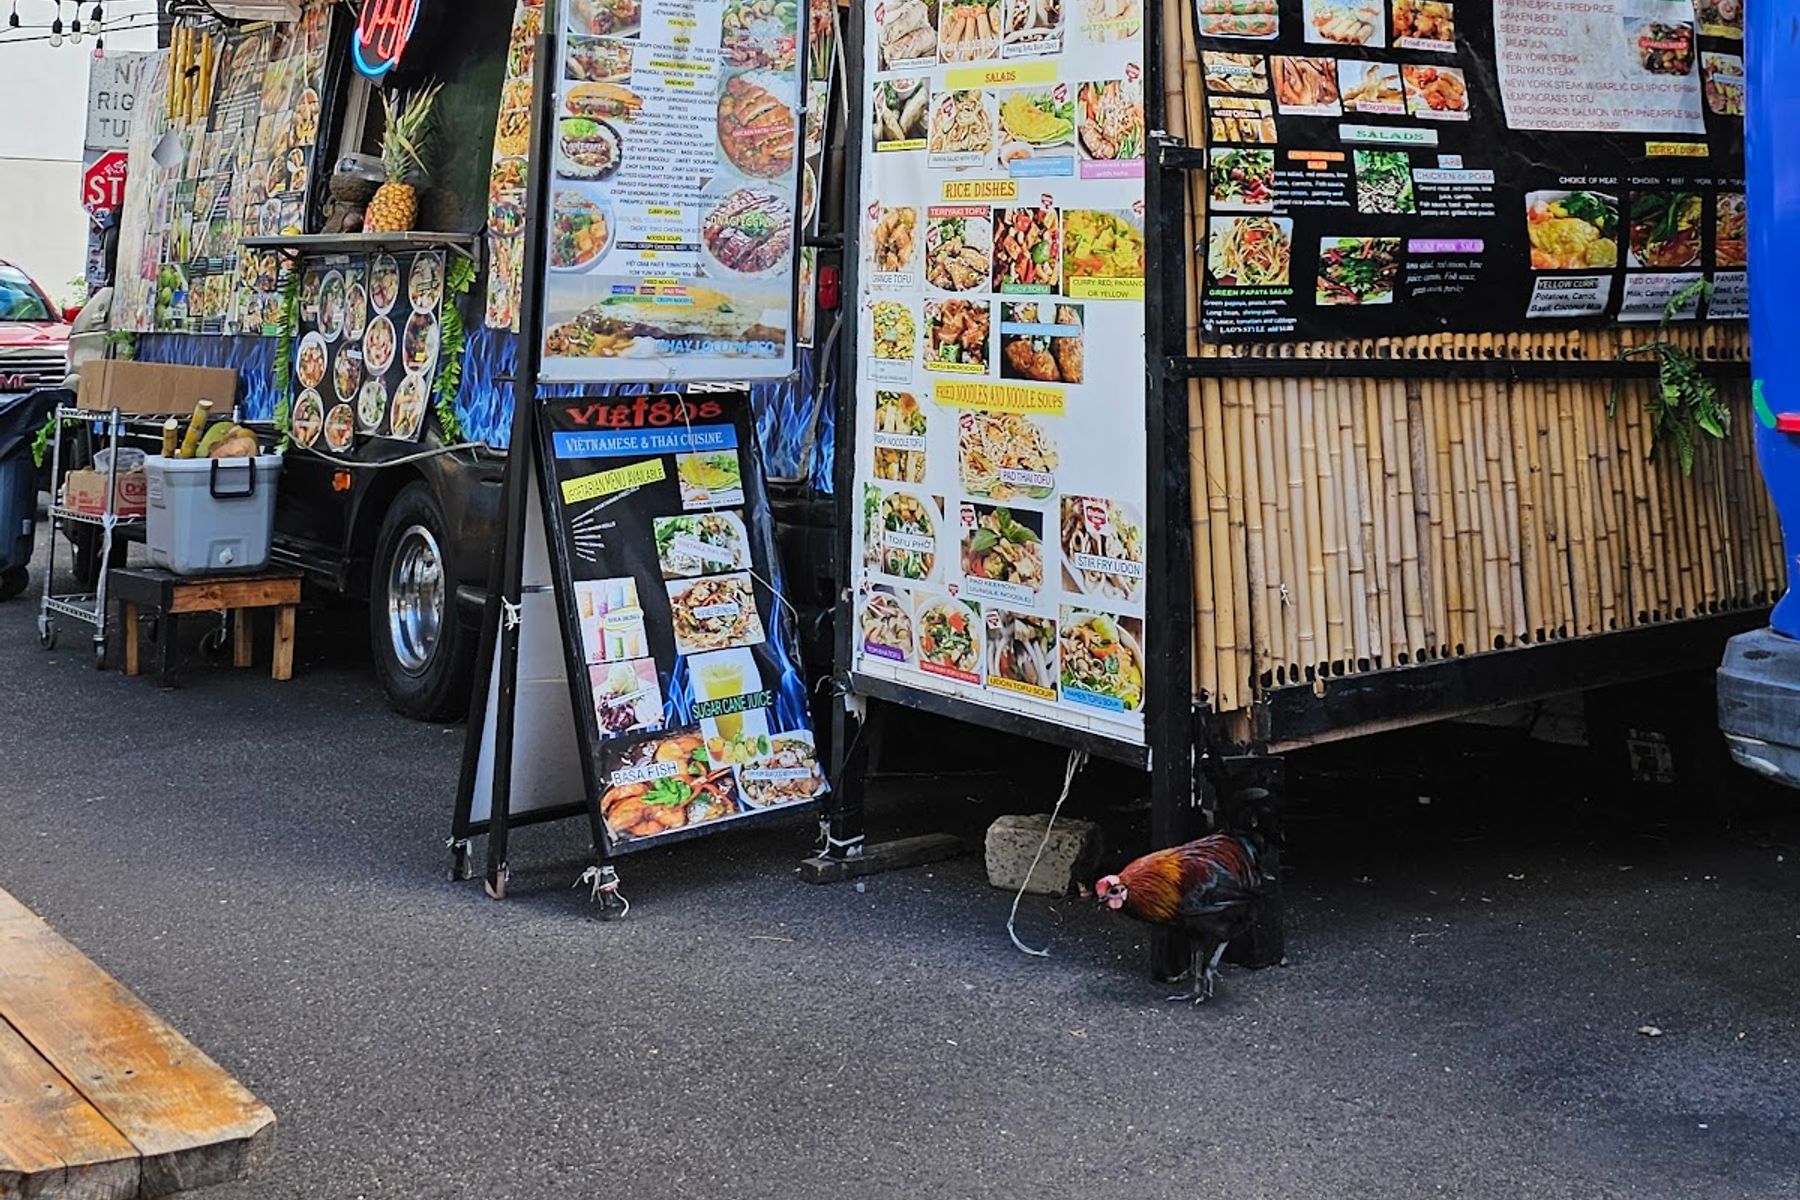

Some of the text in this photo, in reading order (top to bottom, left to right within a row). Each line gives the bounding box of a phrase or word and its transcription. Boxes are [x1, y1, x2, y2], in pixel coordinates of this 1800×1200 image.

[1516, 0, 1563, 11] PINEAPPLE
[1564, 1, 1593, 12] FRIED
[1593, 4, 1615, 13] RICE
[1500, 24, 1523, 34] BEEF
[1505, 38, 1528, 49] MEAT
[1502, 52, 1580, 64] NEW YORK STEAK
[114, 63, 131, 85] N
[1505, 64, 1576, 76] TERIYAKI STEAK
[984, 71, 1017, 85] SALADS
[1504, 78, 1527, 89] NEW
[1527, 79, 1553, 89] YORK
[1555, 80, 1584, 90] STEAK
[1645, 83, 1673, 93] SPICY
[97, 91, 135, 111] RIG
[1506, 92, 1594, 104] LEMONGRASS TOFU
[1509, 105, 1684, 119] LEMONGRASS SALMON WITH PINEAPPLE
[1535, 119, 1551, 128] OR
[1551, 119, 1586, 129] GARLIC
[1356, 129, 1425, 141] SALADS
[1648, 144, 1678, 154] CURRY
[1415, 171, 1494, 182] CHICKEN PORK
[1558, 176, 1587, 185] CHOICE
[1588, 177, 1599, 185] OF
[88, 175, 124, 206] ST
[944, 180, 1016, 199] RICE DISHES
[930, 206, 987, 218] TERIYAKI TOFU
[893, 272, 913, 286] TOFU
[1072, 279, 1097, 289] CURRY
[1539, 280, 1572, 289] YELLOW
[1087, 290, 1129, 299] OR YELLOW
[1208, 288, 1239, 297] GREEN
[1269, 287, 1294, 296] SALAD
[0, 374, 41, 390] MC
[936, 384, 1063, 409] FRIED NOODLES AND NOODLE SOUPS
[640, 438, 649, 449] &
[680, 431, 725, 447] CUISINE
[567, 467, 665, 502] VEGETARIAN MENU AVAILABLE
[1002, 470, 1017, 482] PAD
[1033, 474, 1051, 486] TOFU
[887, 535, 909, 547] TOFU
[1077, 554, 1141, 576] STIR FRY UDON
[988, 677, 1055, 697] UDON TOFU SOUP
[691, 690, 774, 721] SUGAR CANE JUICE
[613, 762, 678, 786] BASA FISH
